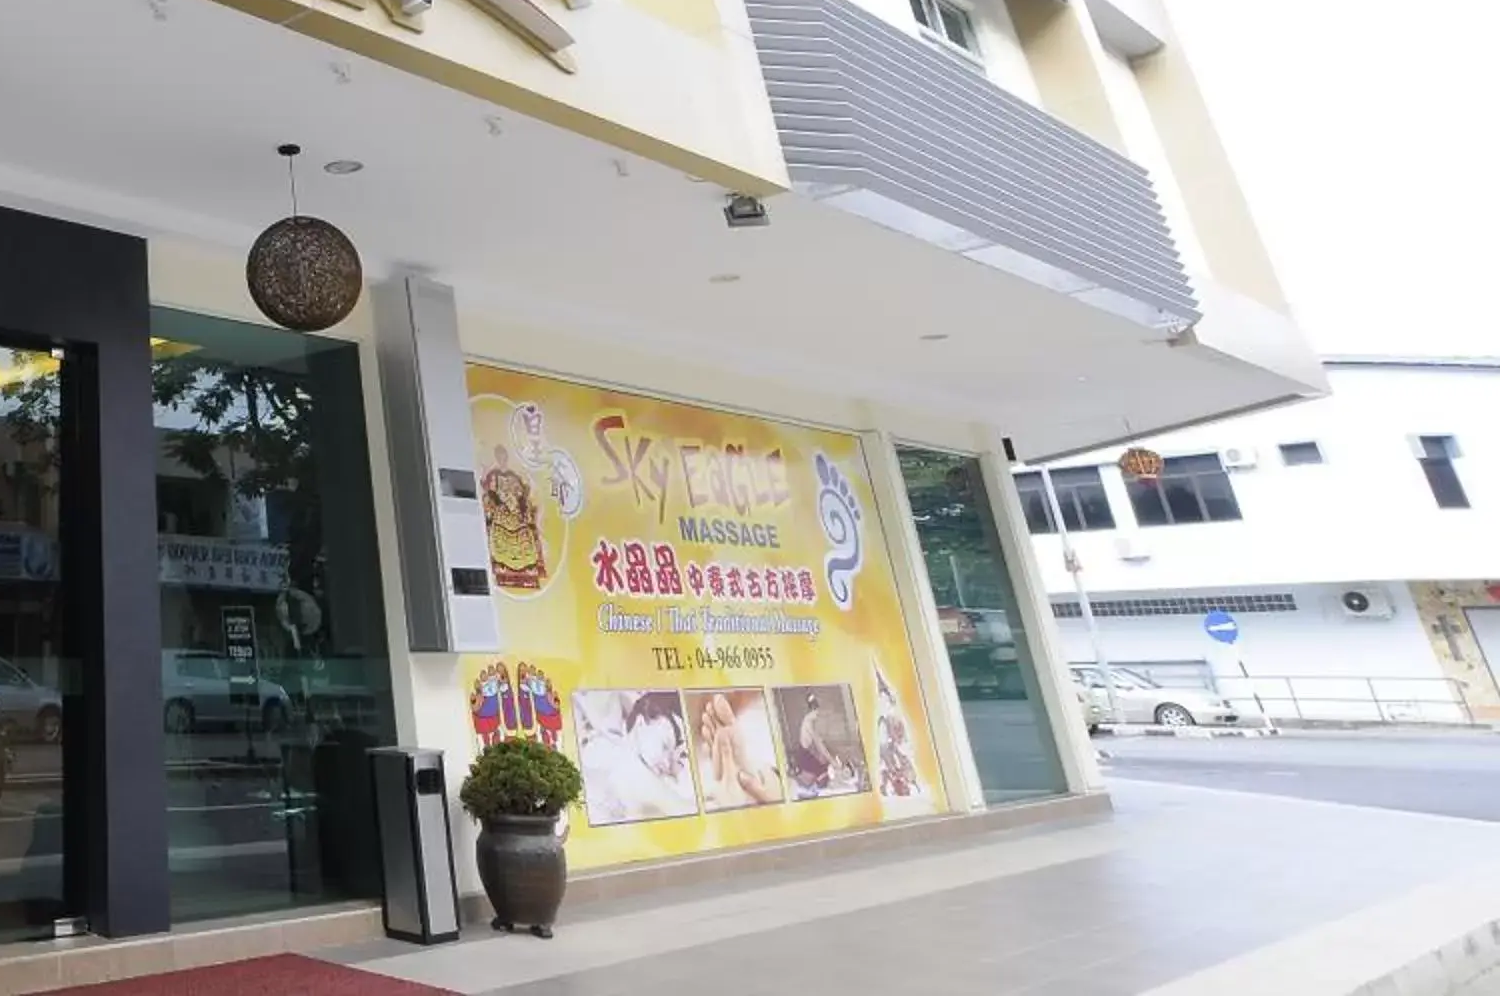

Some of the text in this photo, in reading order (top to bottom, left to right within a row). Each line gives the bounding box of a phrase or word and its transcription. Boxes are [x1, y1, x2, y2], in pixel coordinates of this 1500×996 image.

[679, 516, 780, 548] MASSAGE
[652, 648, 685, 670] TEL
[695, 648, 742, 669] 04-966
[743, 648, 774, 669] 0955
